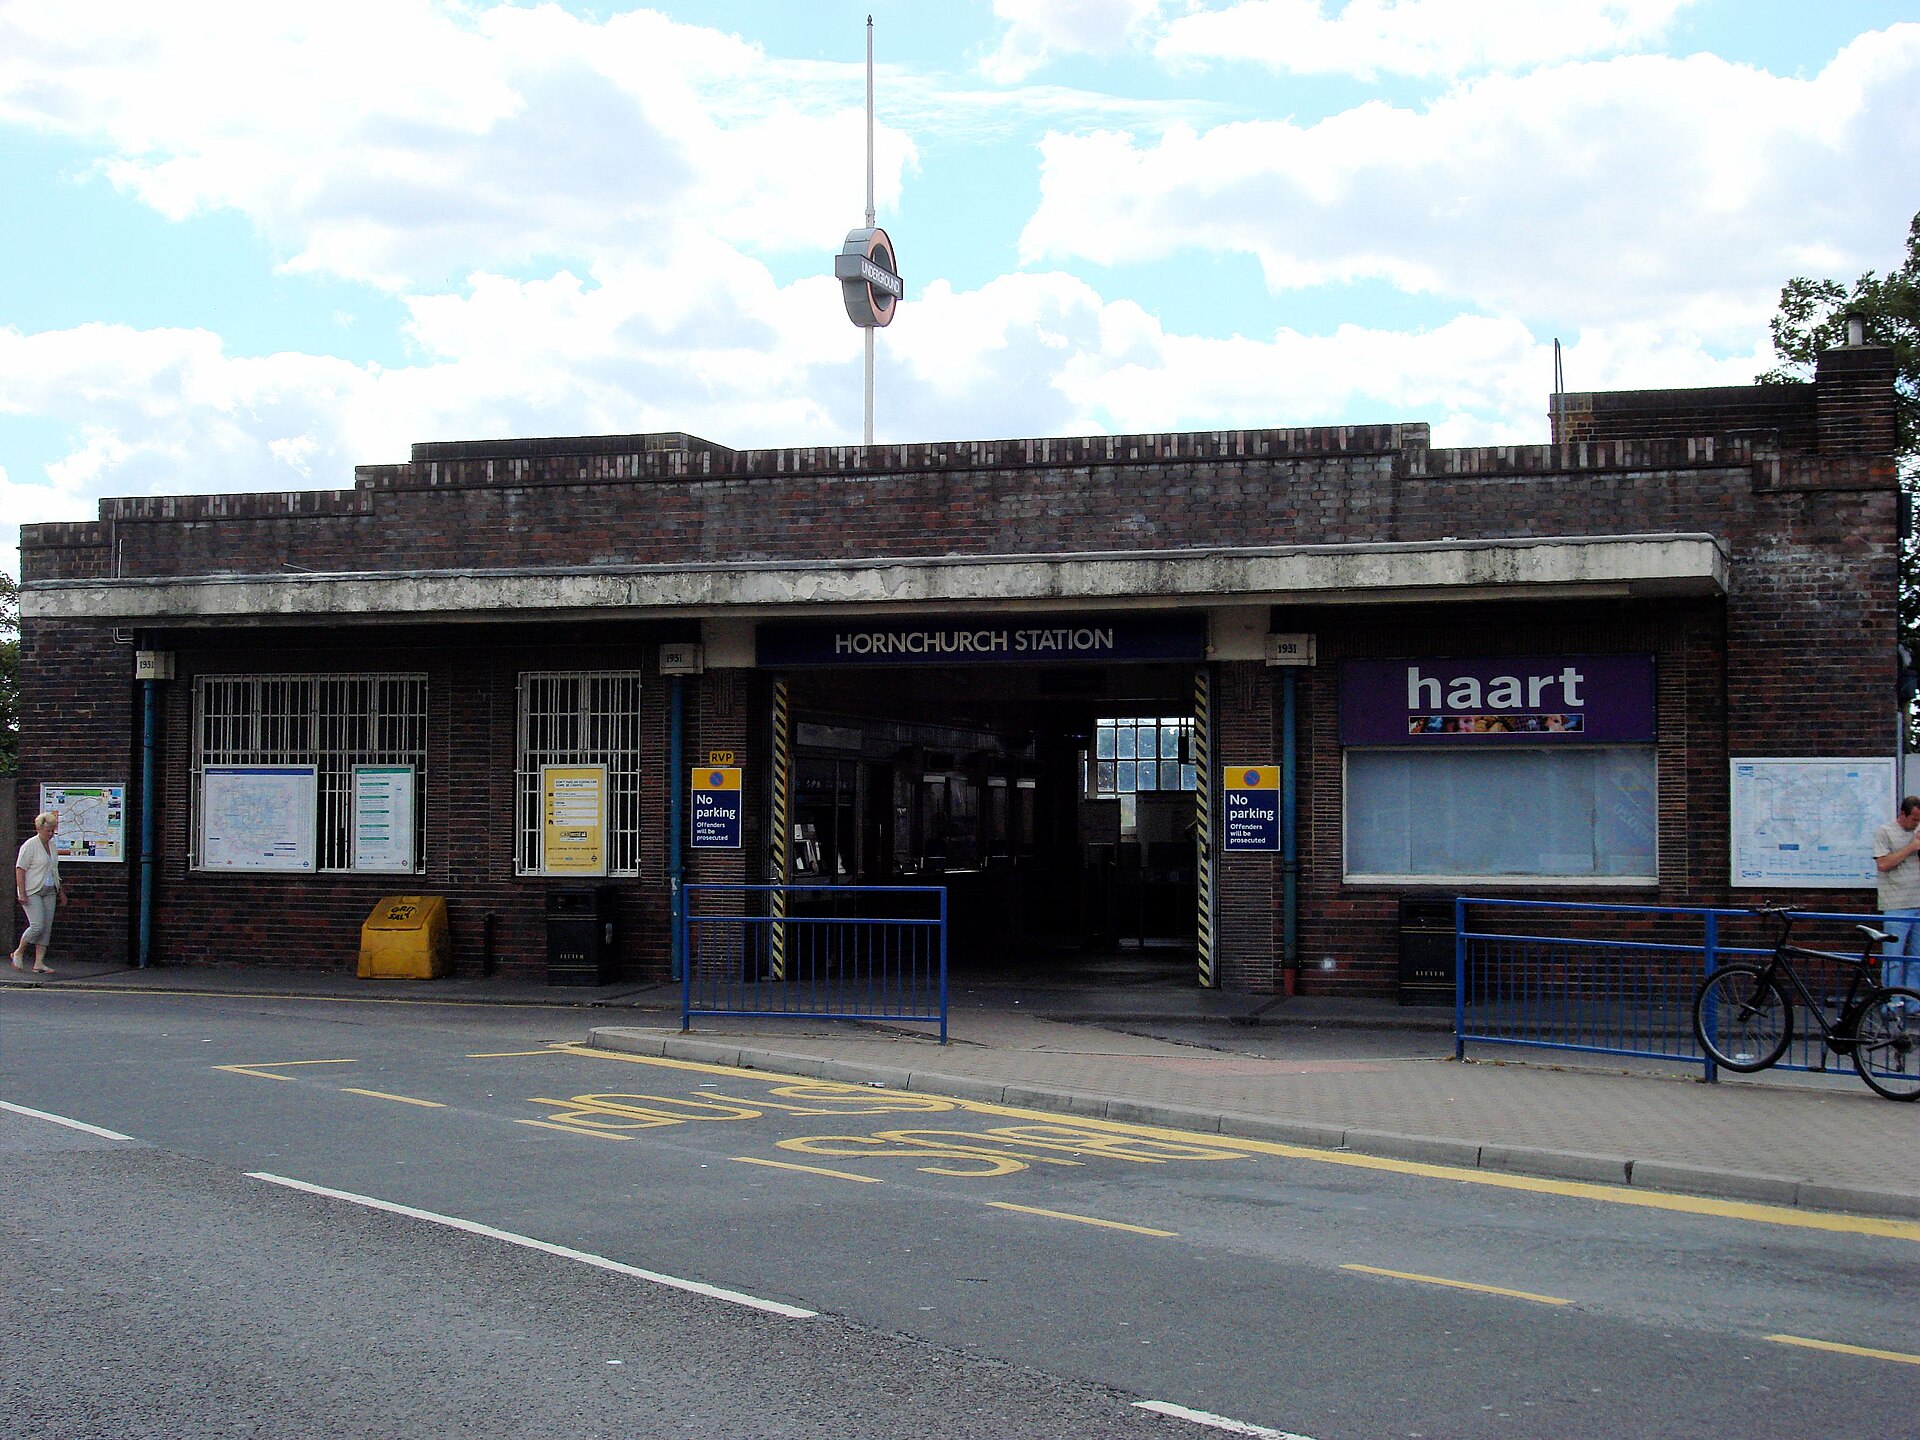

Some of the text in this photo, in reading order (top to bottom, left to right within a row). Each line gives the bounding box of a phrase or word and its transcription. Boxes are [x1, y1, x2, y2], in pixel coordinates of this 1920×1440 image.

[835, 628, 1114, 654] HORNCHURCH STATION
[1277, 643, 1297, 654] 1931
[666, 653, 683, 663] 1931
[1407, 666, 1585, 710] haart
[711, 753, 732, 762] RVP
[696, 794, 713, 805] No
[1229, 794, 1248, 805] No
[696, 807, 736, 820] parking
[1229, 807, 1274, 821] parking
[391, 905, 416, 913] GRIT
[527, 1085, 956, 1130] STOP
[774, 1125, 1252, 1178] BUS
